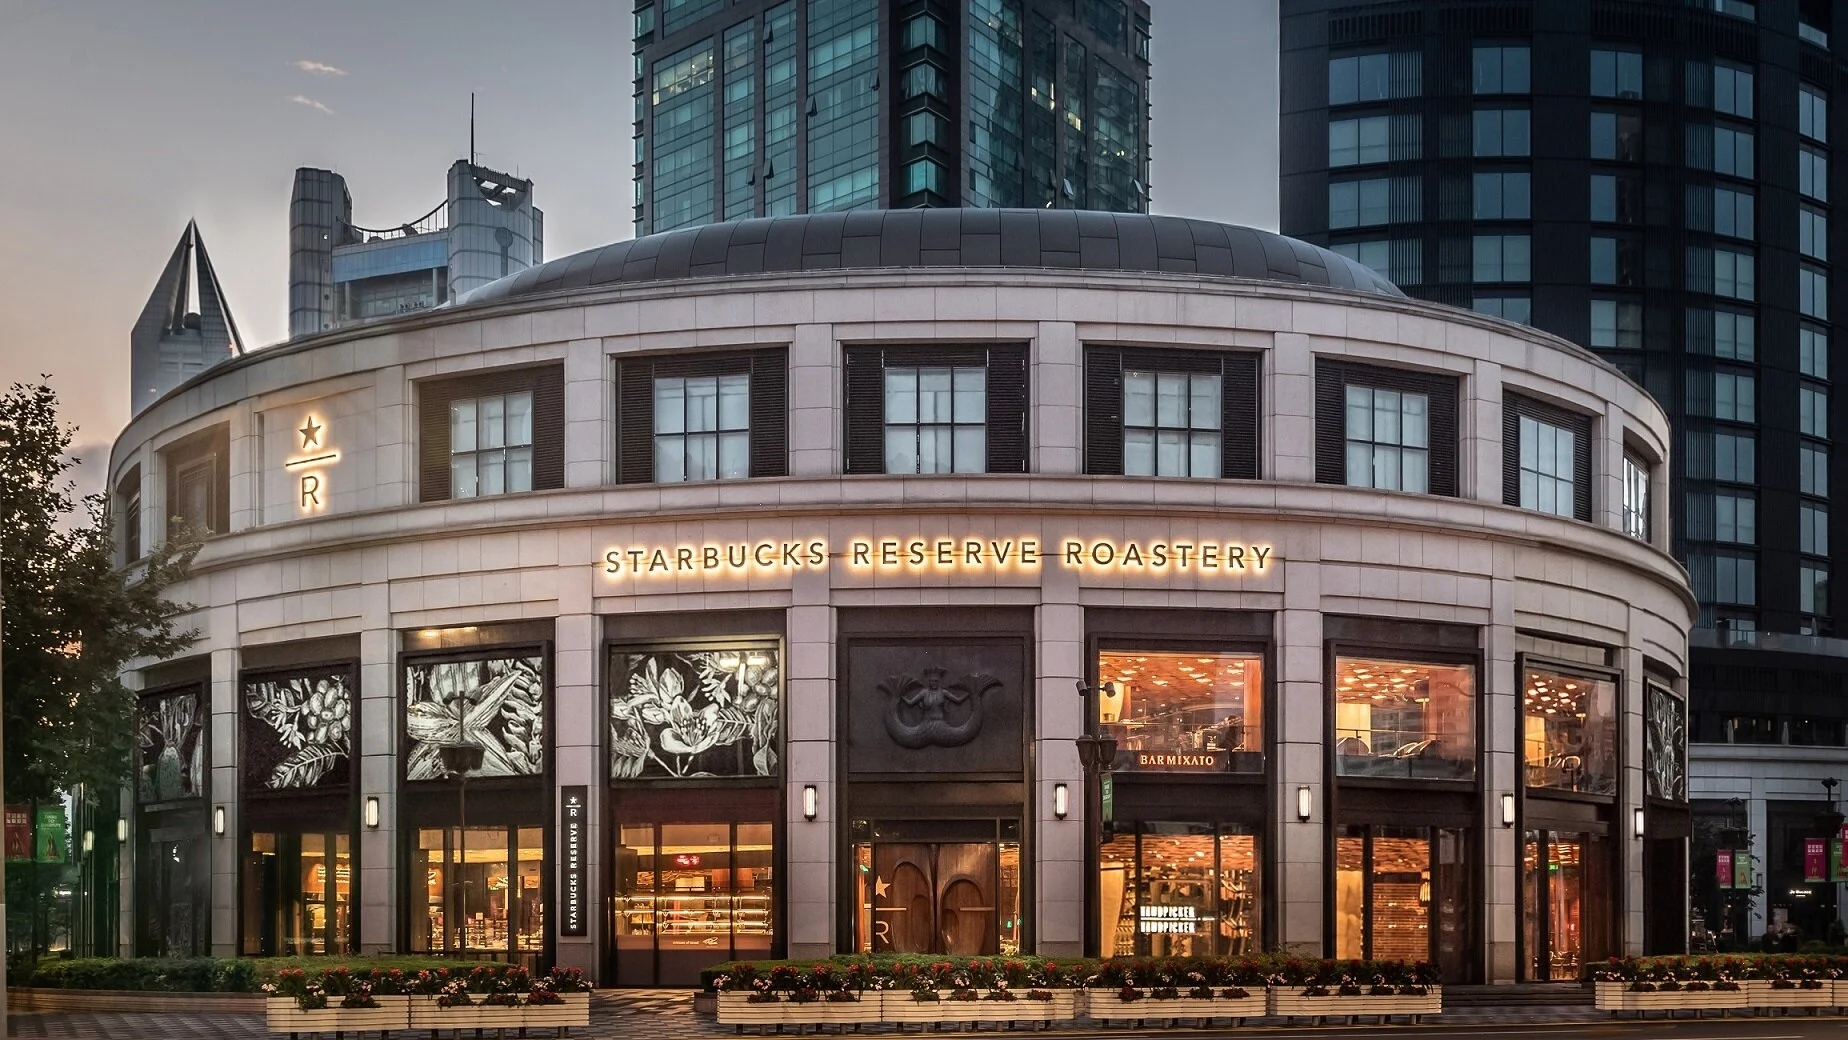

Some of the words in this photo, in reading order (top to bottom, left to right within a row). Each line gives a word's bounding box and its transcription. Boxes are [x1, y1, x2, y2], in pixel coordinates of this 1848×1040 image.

[302, 475, 319, 507] R
[606, 542, 824, 573] STARBUCKS
[853, 541, 1037, 565] RESERVE
[1066, 542, 1271, 569] ROASTERY
[570, 808, 577, 817] R
[570, 823, 578, 869] RESERVE
